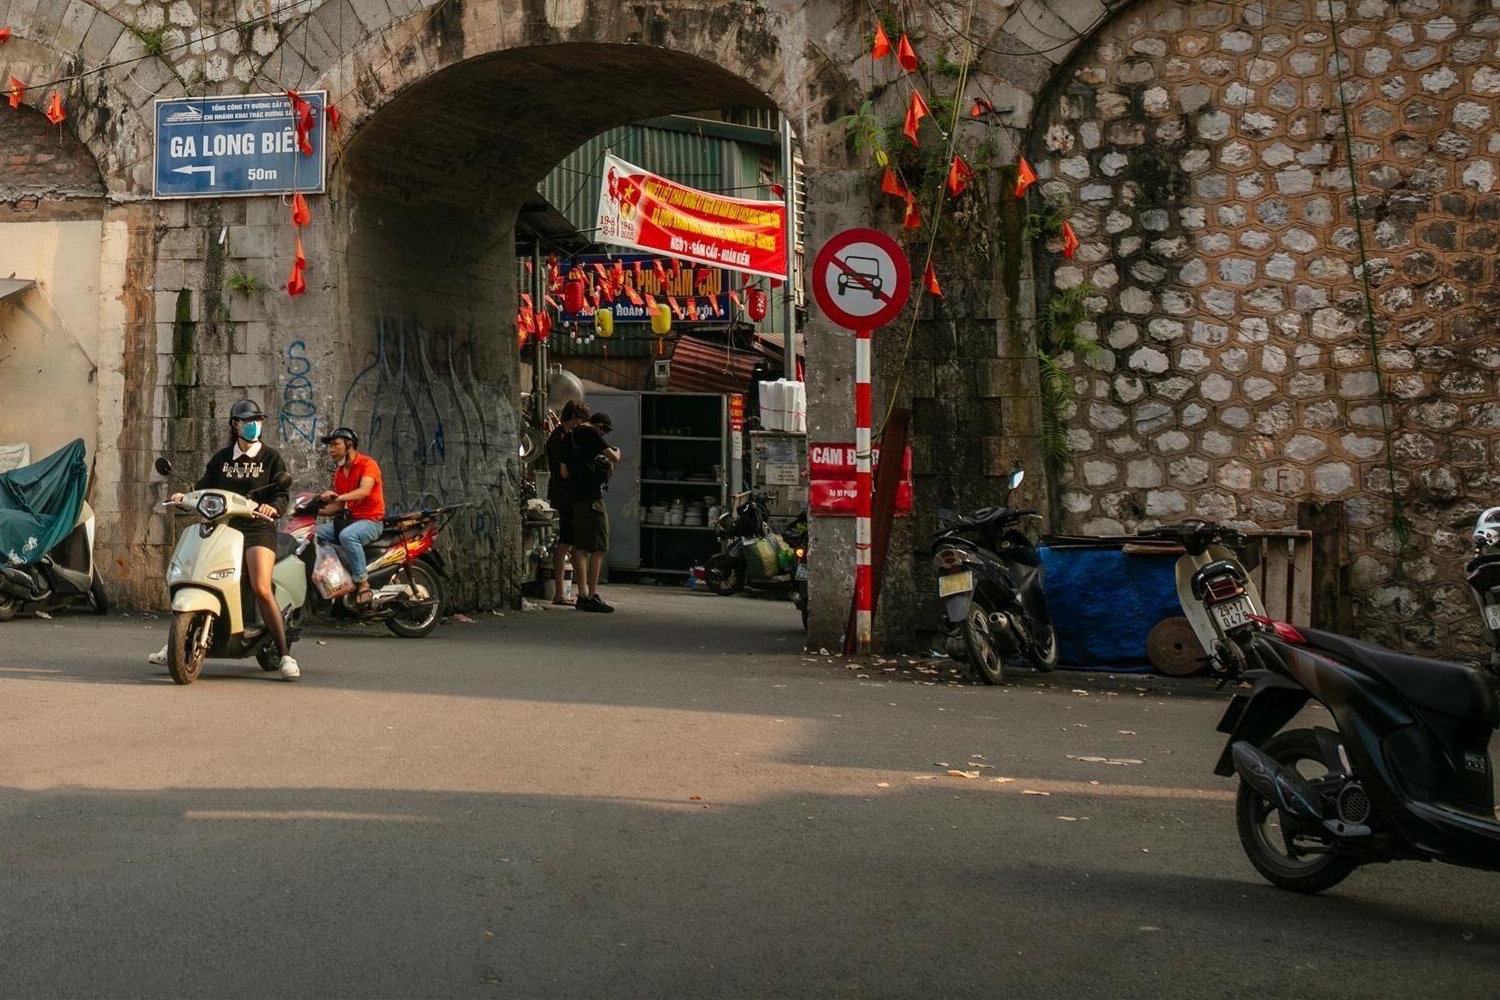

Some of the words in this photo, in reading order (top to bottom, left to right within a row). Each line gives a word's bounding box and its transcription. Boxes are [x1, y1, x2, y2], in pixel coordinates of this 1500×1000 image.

[170, 135, 197, 158] GA
[202, 132, 255, 157] LONG
[248, 168, 277, 180] 50m
